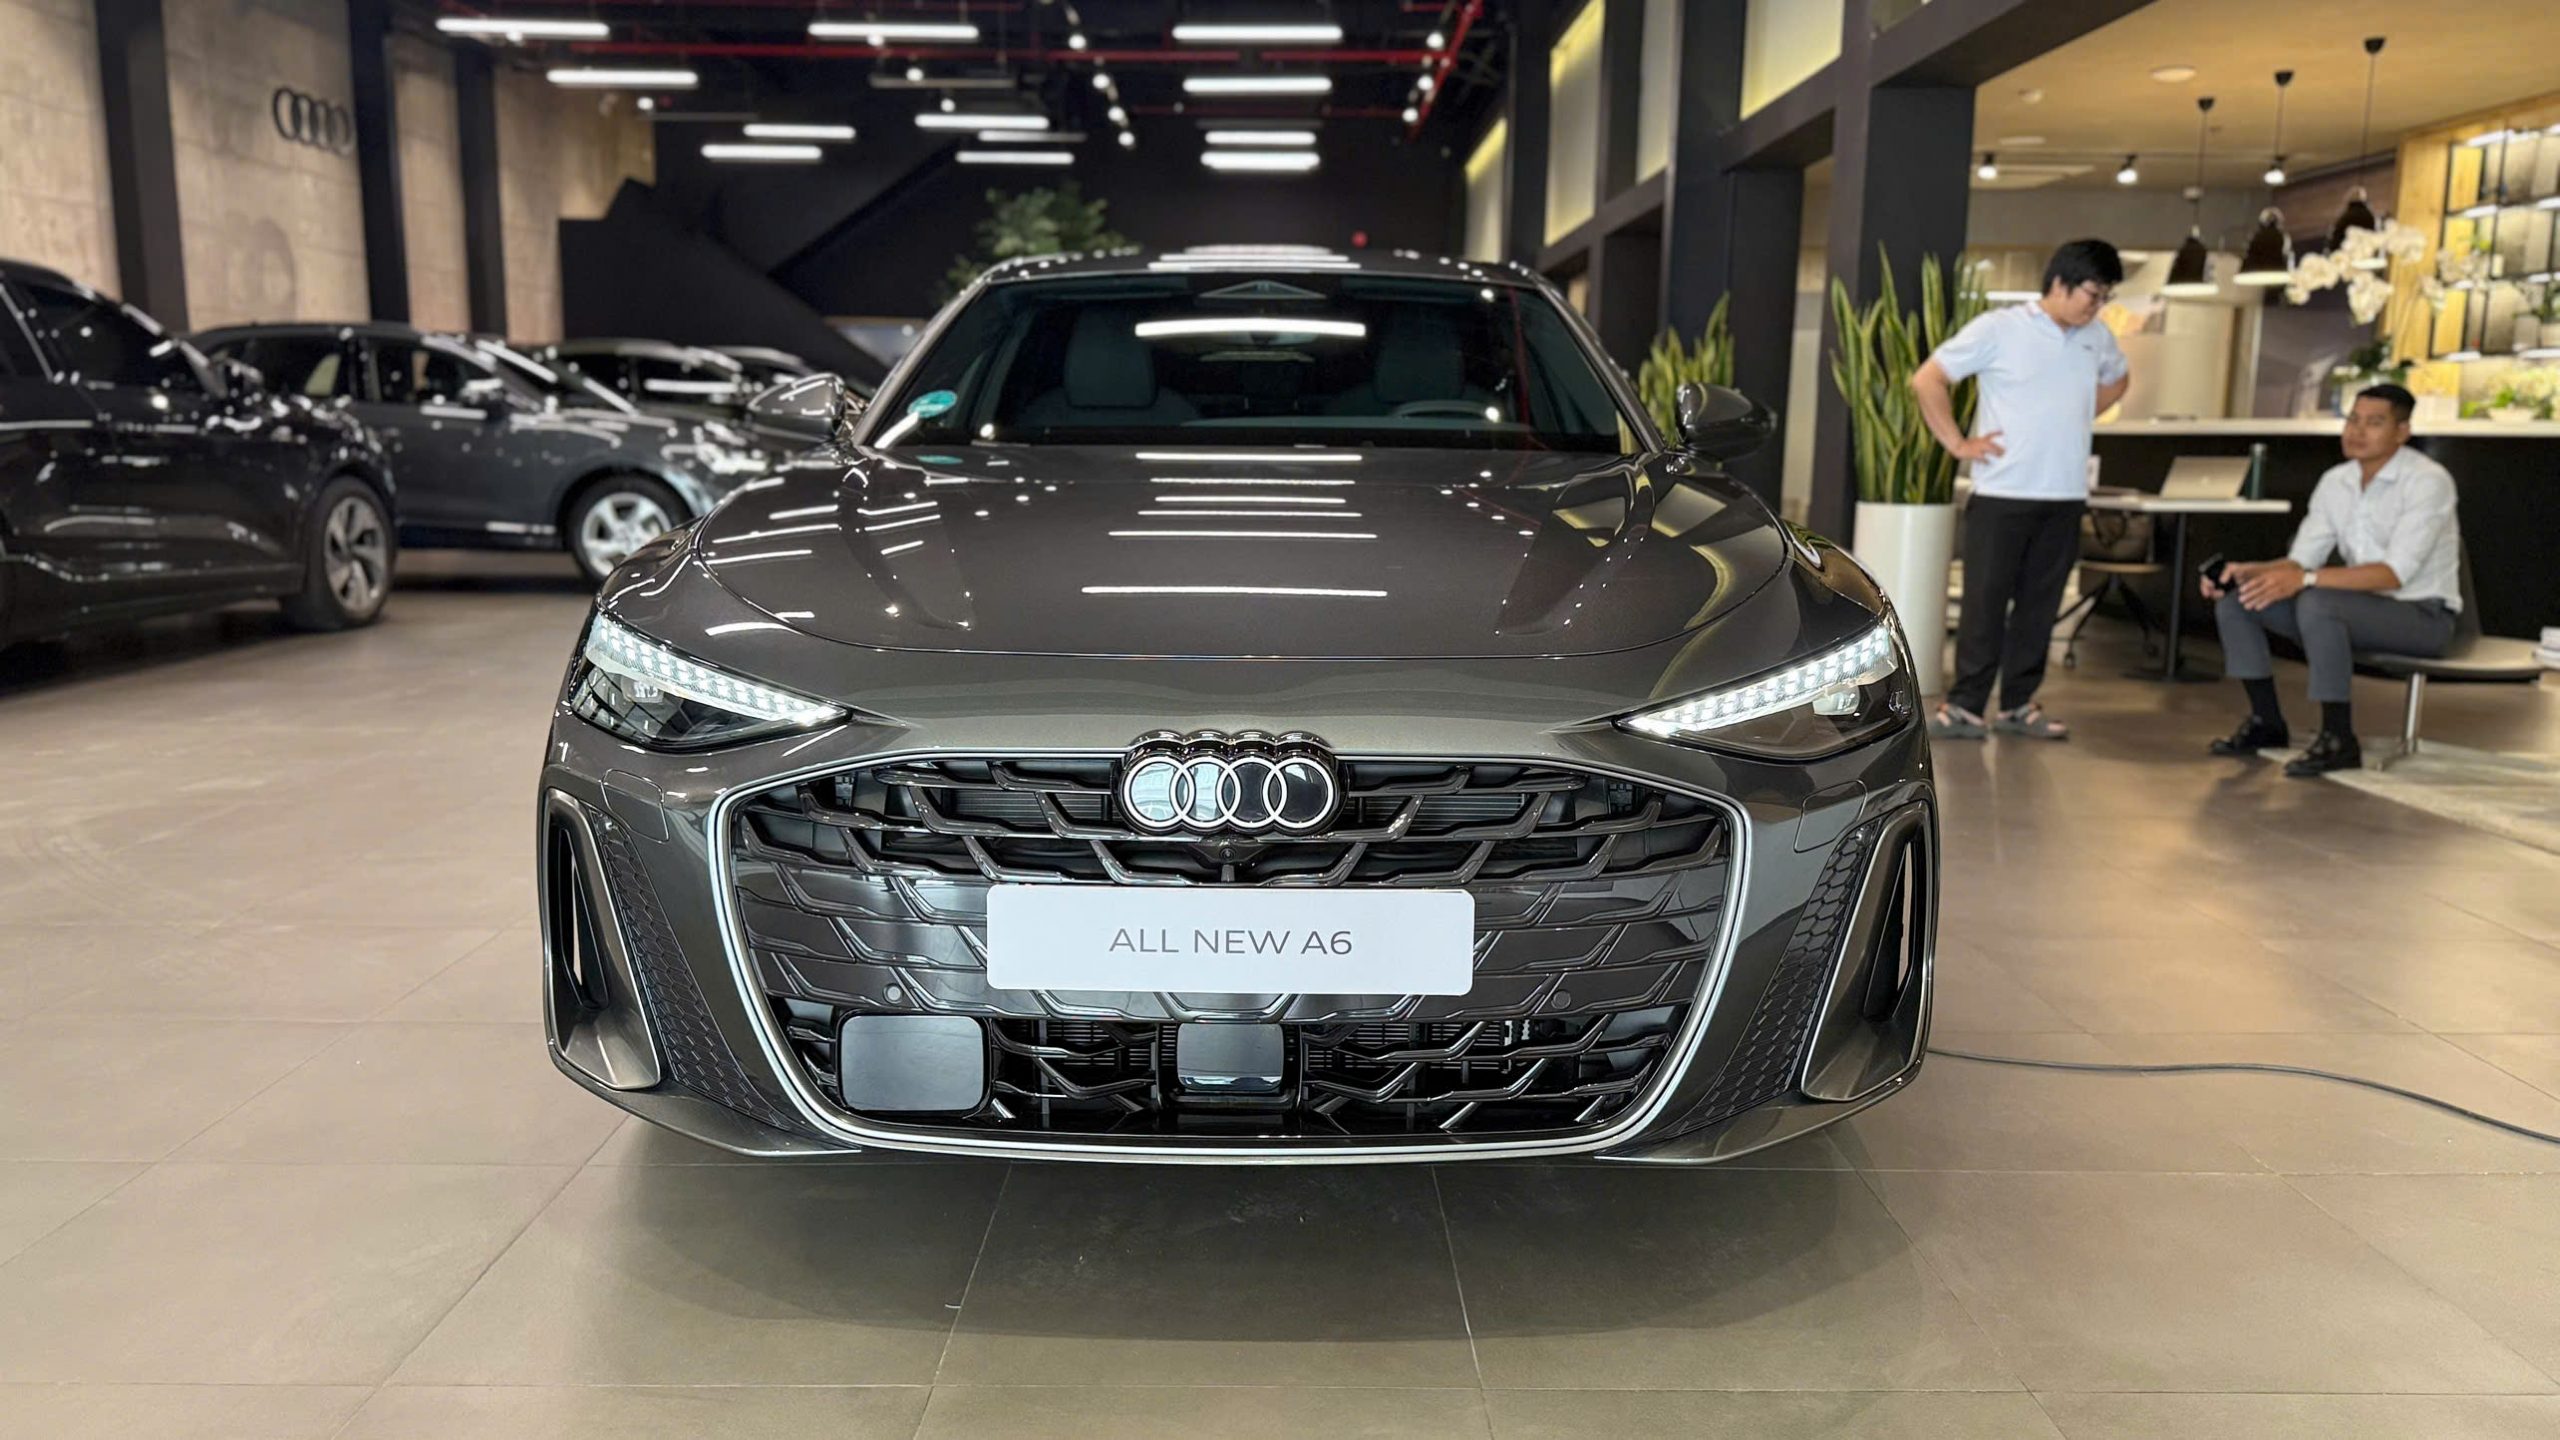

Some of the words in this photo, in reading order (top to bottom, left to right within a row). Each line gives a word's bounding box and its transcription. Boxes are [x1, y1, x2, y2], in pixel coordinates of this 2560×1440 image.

[1109, 928, 1179, 953] ALL
[1194, 929, 1290, 954] NEW
[1300, 930, 1353, 955] A6
